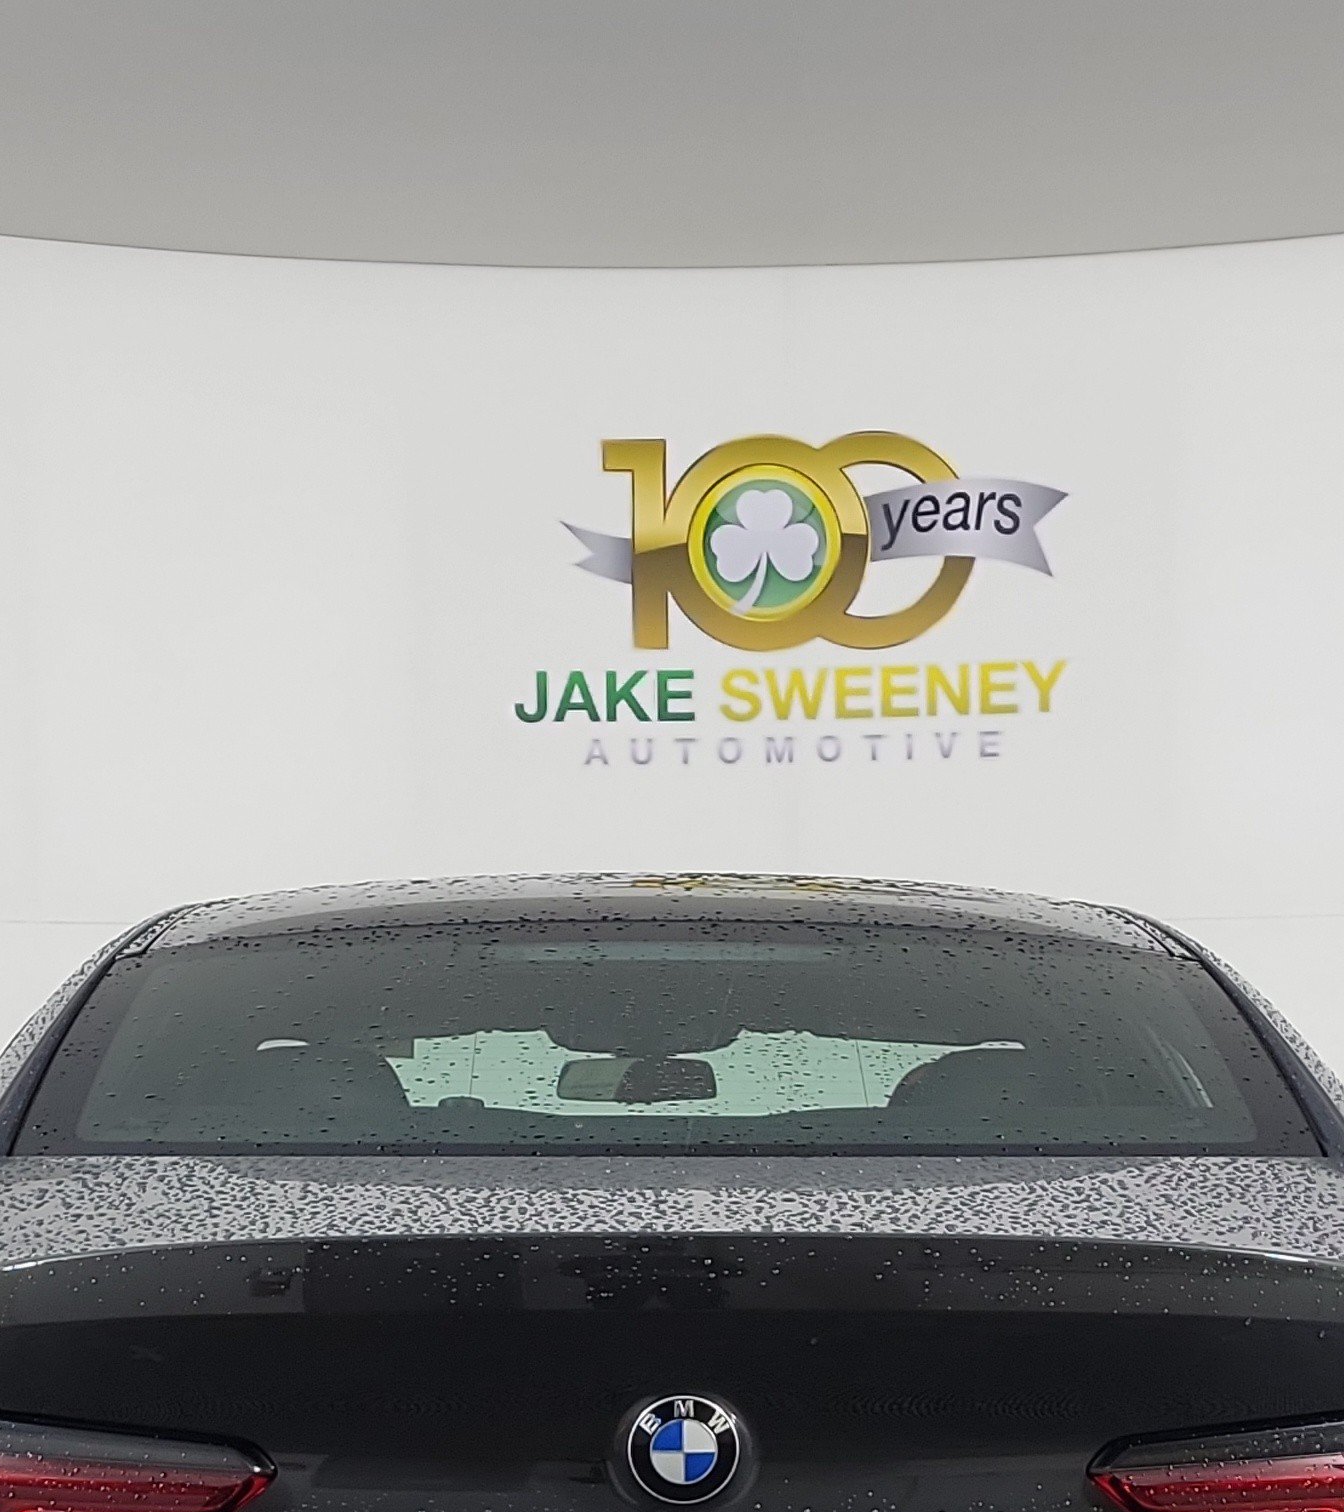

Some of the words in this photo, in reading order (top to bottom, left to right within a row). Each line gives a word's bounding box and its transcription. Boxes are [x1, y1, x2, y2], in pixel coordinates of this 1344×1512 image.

[601, 431, 975, 651] 100
[881, 489, 1022, 551] years
[514, 669, 695, 722] JAKE
[718, 660, 1066, 722] SWEENEY
[584, 730, 1003, 765] AUTOMOTIVE
[638, 1399, 731, 1436] BMW
